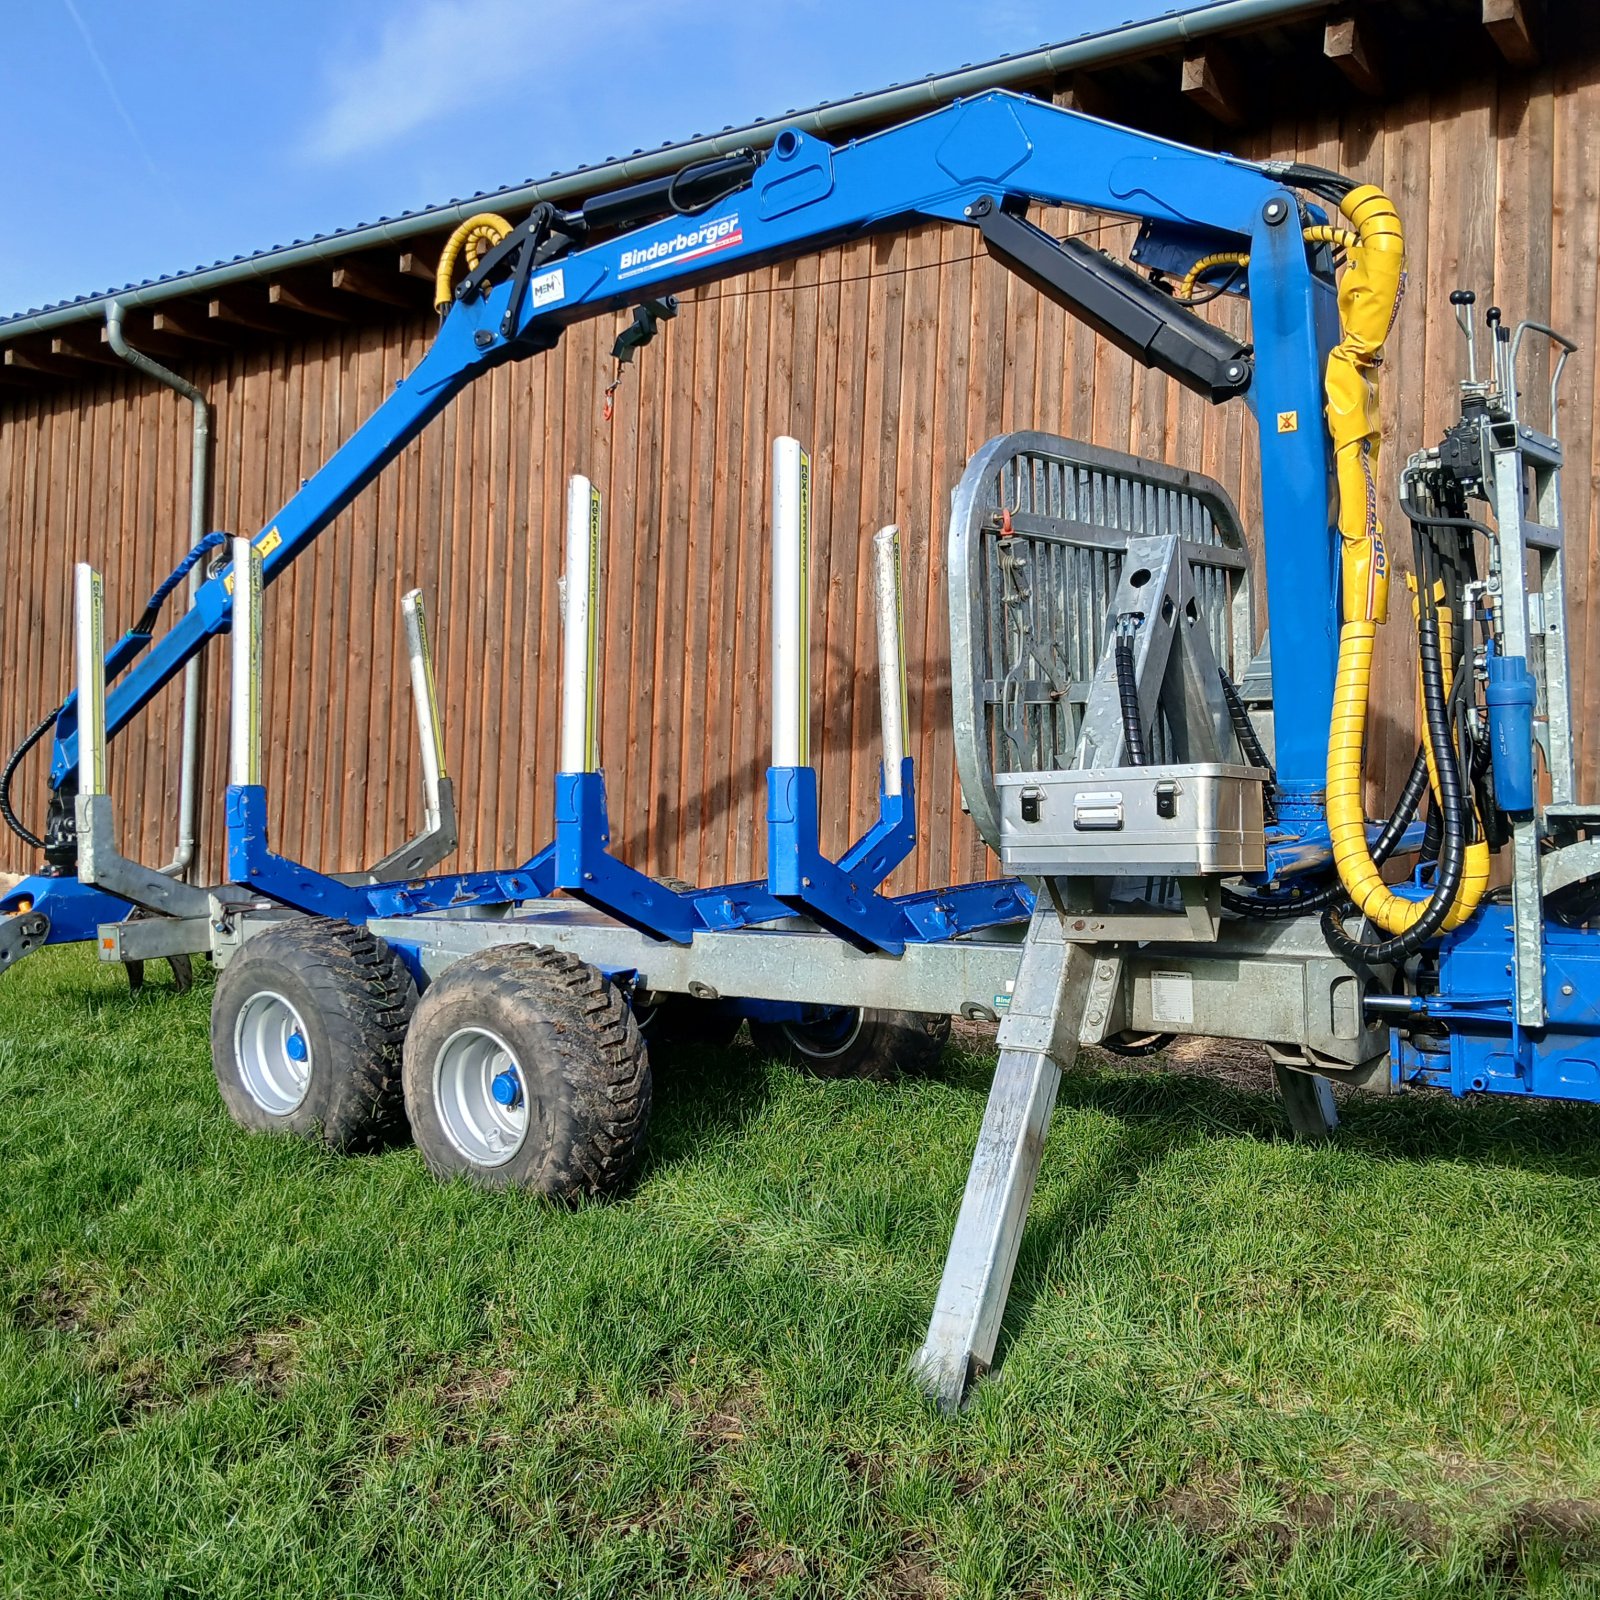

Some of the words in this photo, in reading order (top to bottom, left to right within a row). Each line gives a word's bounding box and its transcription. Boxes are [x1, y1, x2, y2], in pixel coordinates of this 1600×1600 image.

[620, 216, 739, 270] Binderberger
[801, 464, 809, 503] next
[591, 499, 599, 535] next
